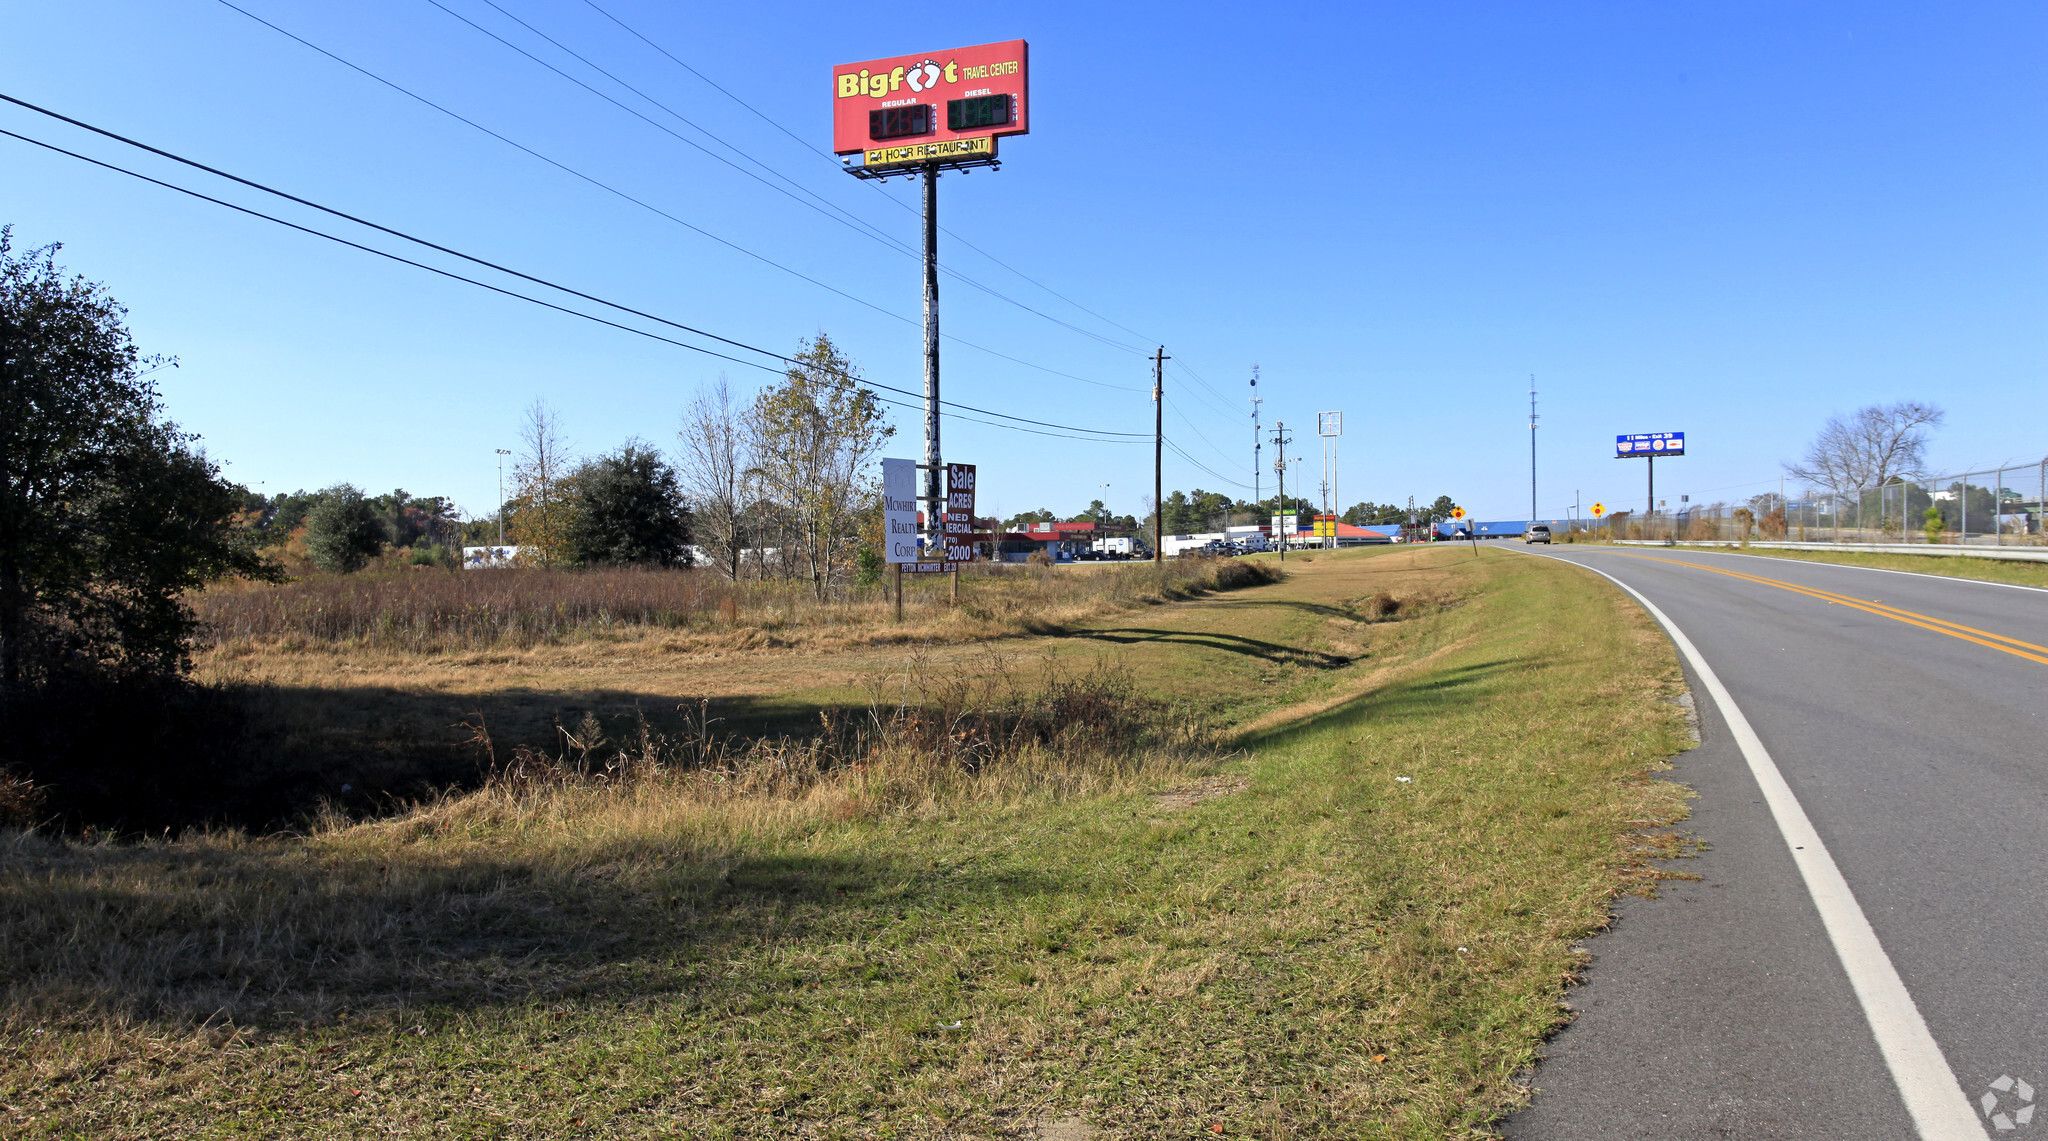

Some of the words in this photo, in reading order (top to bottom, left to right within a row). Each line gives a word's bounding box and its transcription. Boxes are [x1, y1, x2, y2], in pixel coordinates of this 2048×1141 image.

[962, 65, 990, 80] TRAVEL
[990, 61, 1018, 76] CENTER
[964, 88, 992, 97] DIESEL
[882, 98, 917, 108] REGULAR
[951, 465, 974, 489] Sale
[949, 492, 972, 509] ACRES
[947, 513, 969, 522] NED
[891, 519, 917, 534] REALTY
